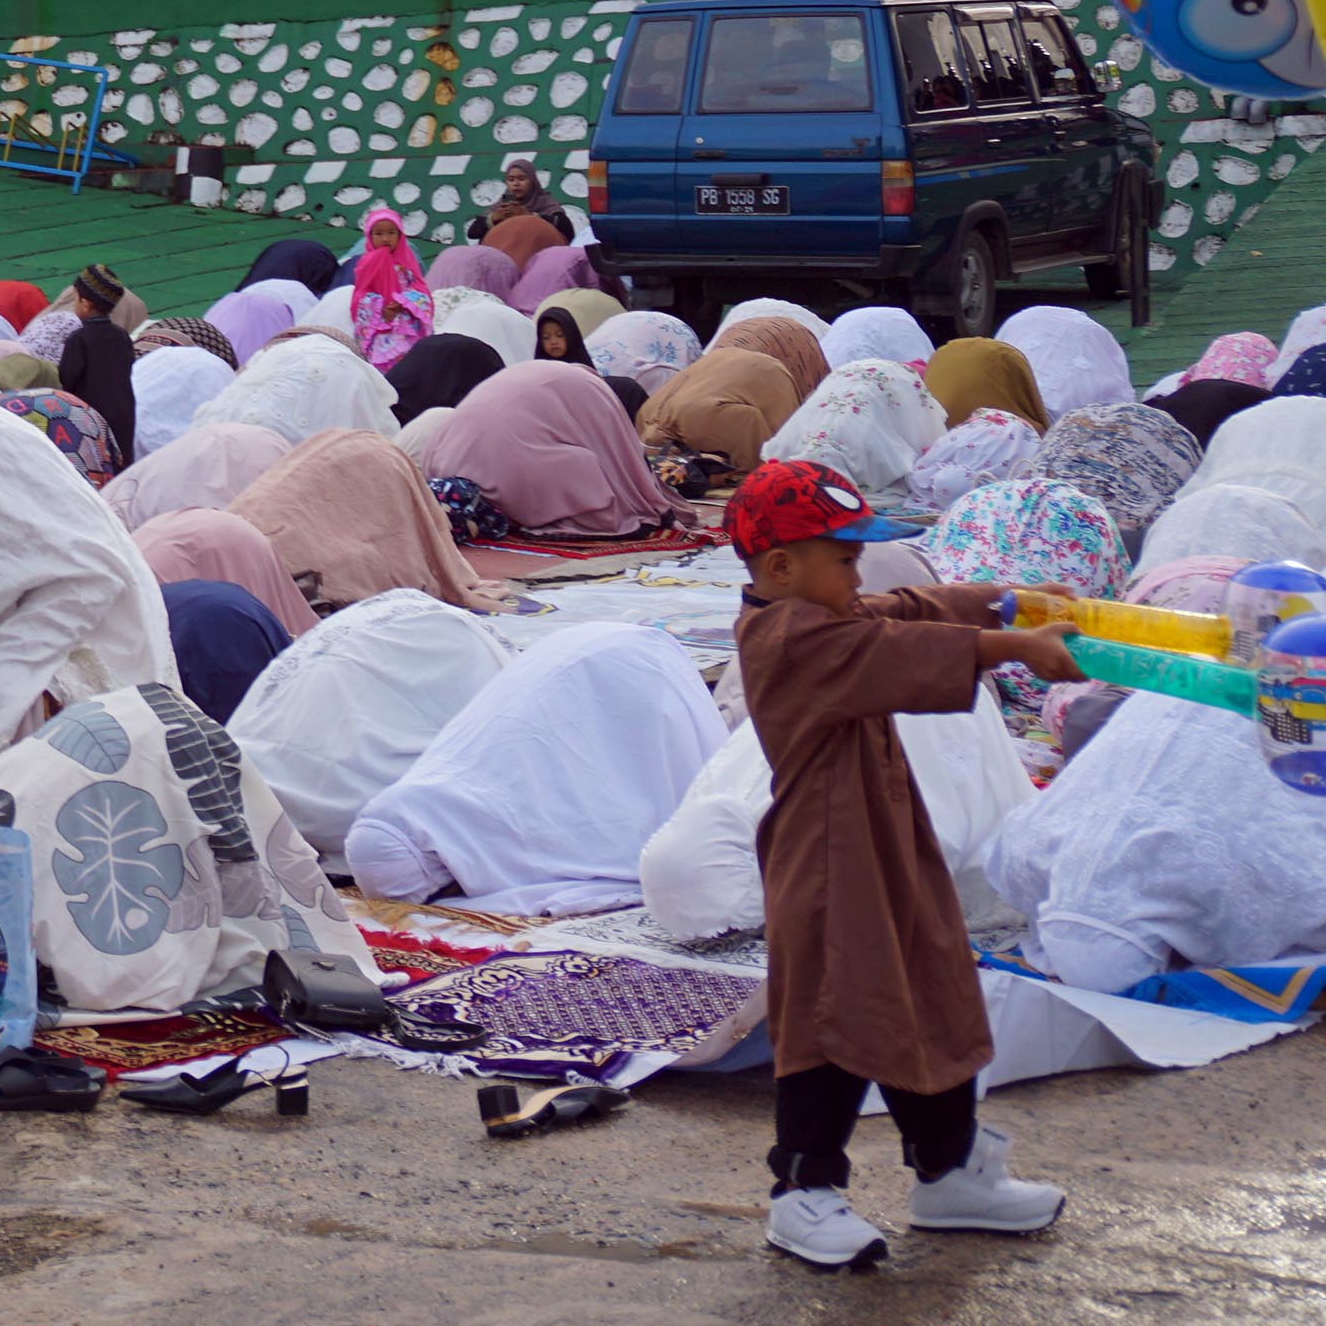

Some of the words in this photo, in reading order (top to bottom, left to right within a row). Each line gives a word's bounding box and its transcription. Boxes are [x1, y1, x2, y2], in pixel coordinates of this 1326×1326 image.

[701, 188, 718, 205] PB
[725, 189, 755, 205] 1558
[762, 188, 780, 205] SG
